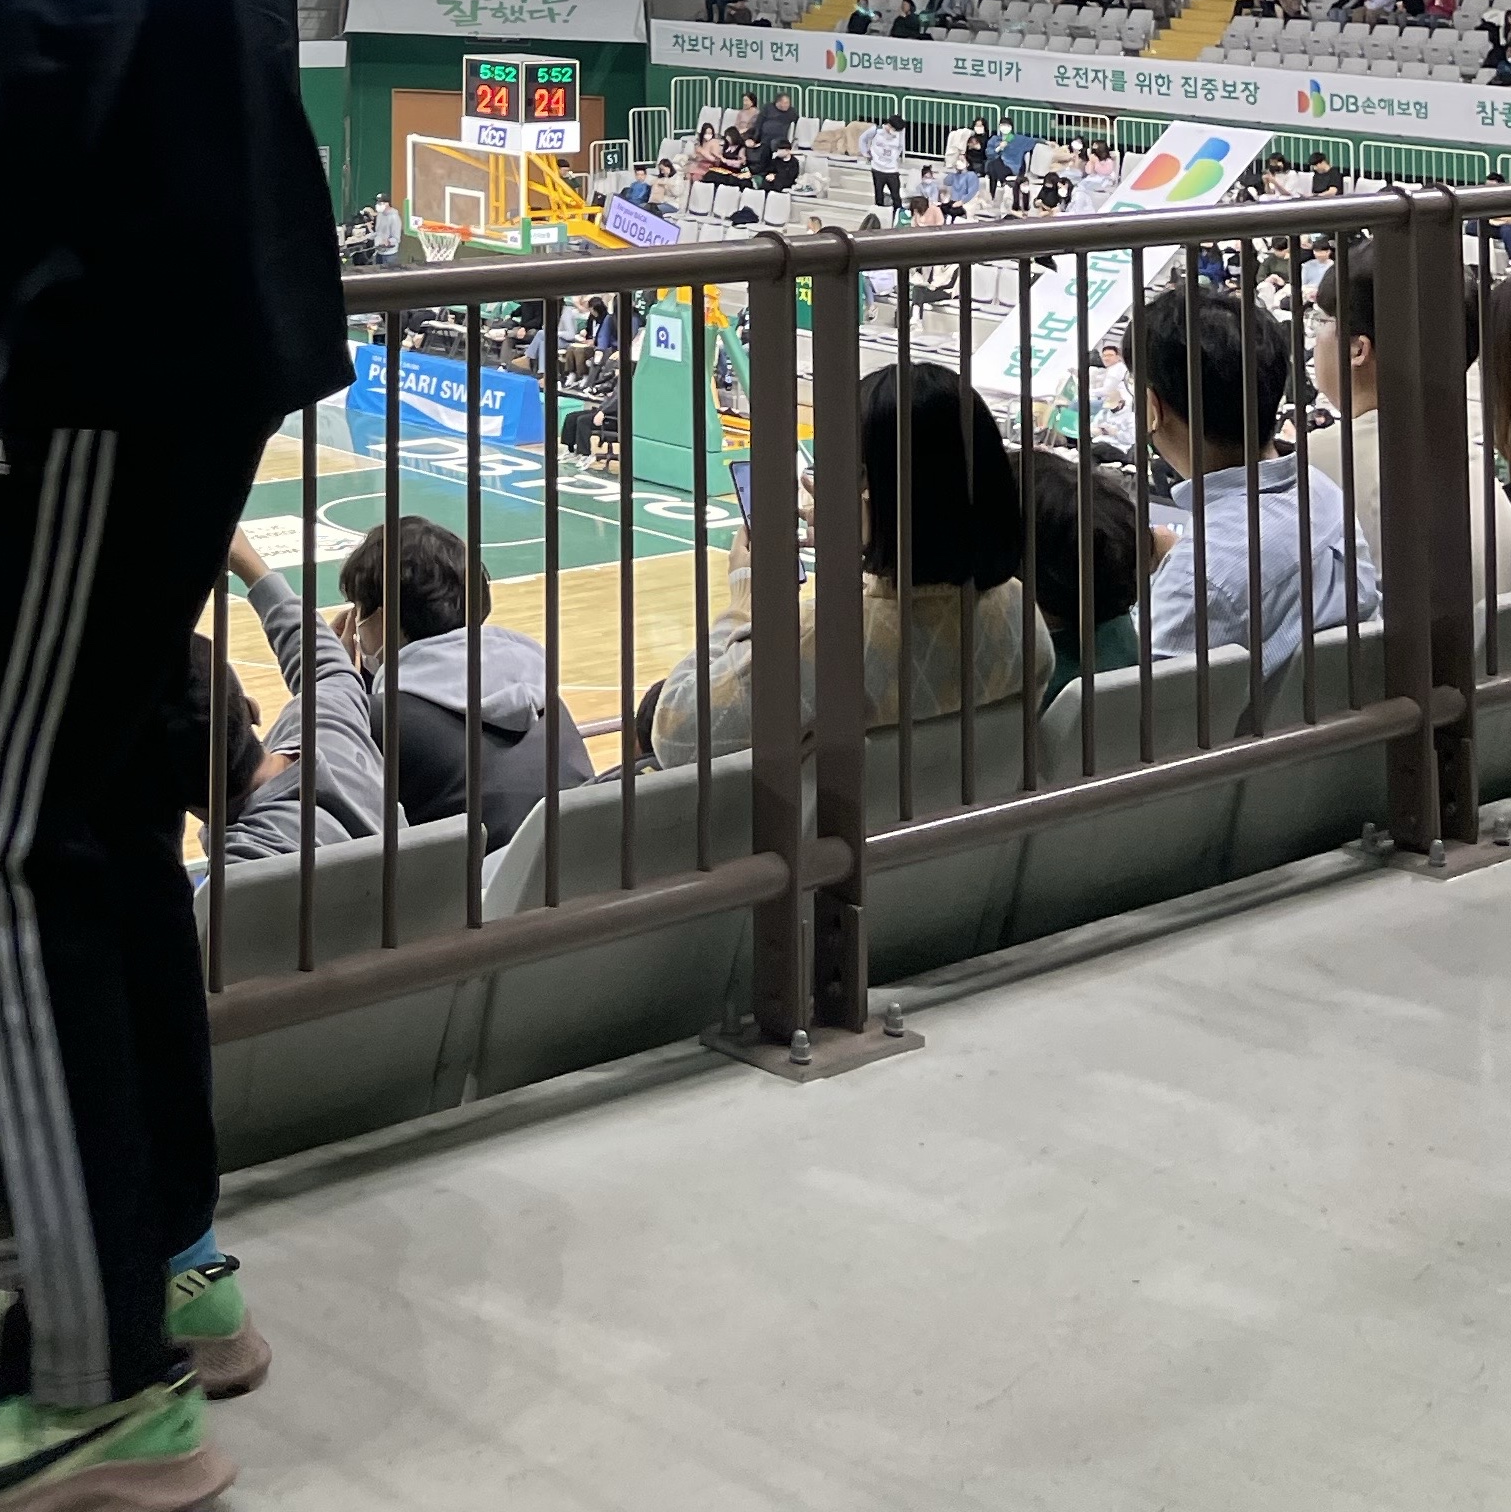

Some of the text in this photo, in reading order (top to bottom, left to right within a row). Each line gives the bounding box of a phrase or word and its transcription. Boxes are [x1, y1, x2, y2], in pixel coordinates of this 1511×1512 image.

[437, 0, 577, 27] 잘했다!
[672, 33, 799, 63] 차보다 사람이 먼저
[479, 64, 517, 83] 5:52
[849, 51, 923, 74] DB손해보험
[952, 57, 1260, 106] 프로미카 운전자를 위한 집중보장
[476, 84, 509, 116] 24
[534, 87, 566, 117] 24
[1330, 93, 1429, 120] DB손해보험
[479, 125, 507, 147] KCC
[537, 128, 564, 149] KCC
[606, 154, 618, 165] S1
[440, 380, 505, 409] SWAT
